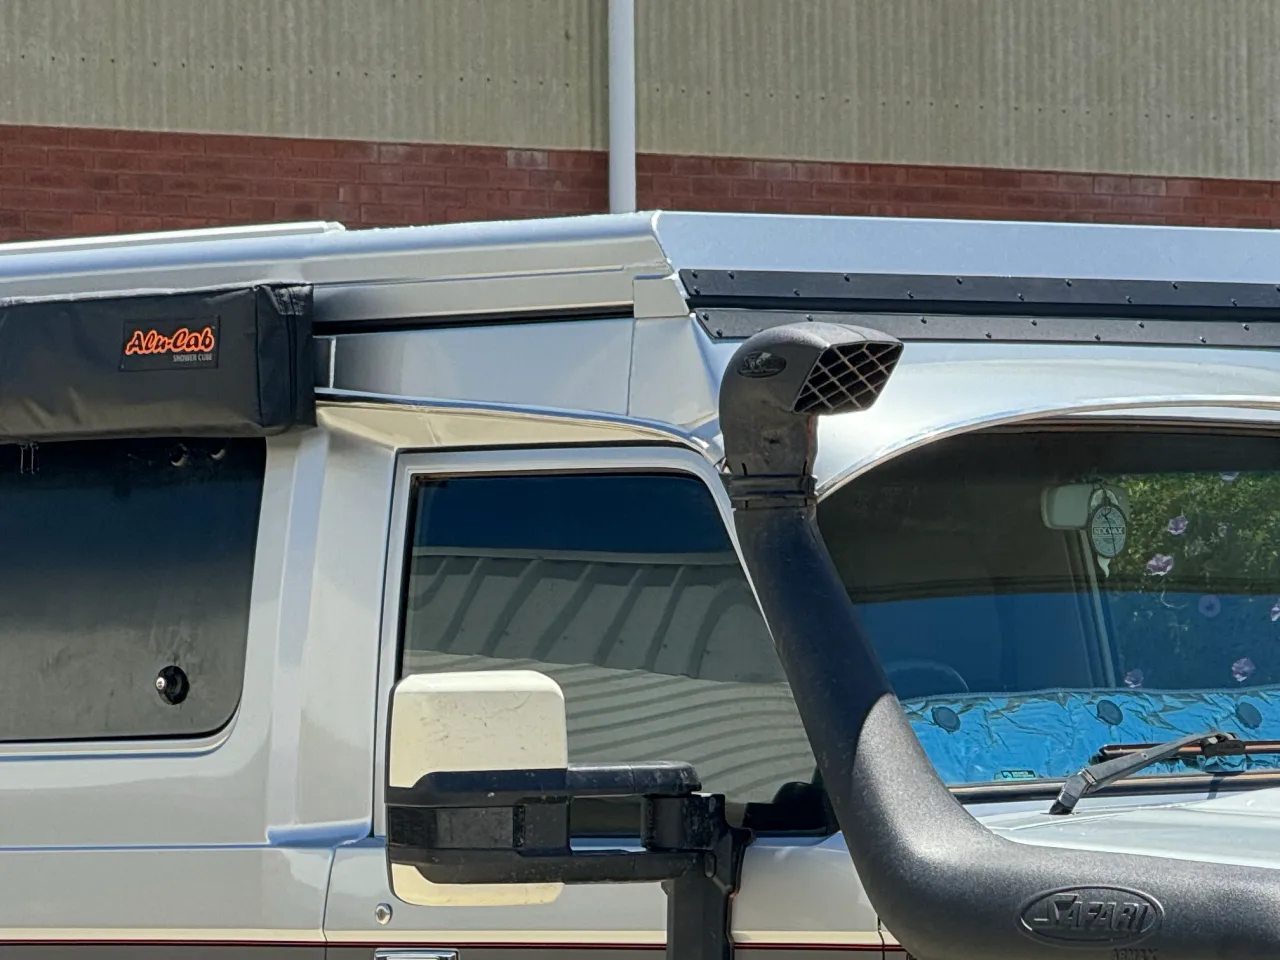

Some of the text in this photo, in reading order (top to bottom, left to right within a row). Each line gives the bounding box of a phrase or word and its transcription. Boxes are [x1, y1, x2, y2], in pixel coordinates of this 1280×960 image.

[126, 327, 214, 355] Alu-Cab
[173, 355, 197, 363] SHOWER
[1033, 893, 1150, 932] SAFARI
